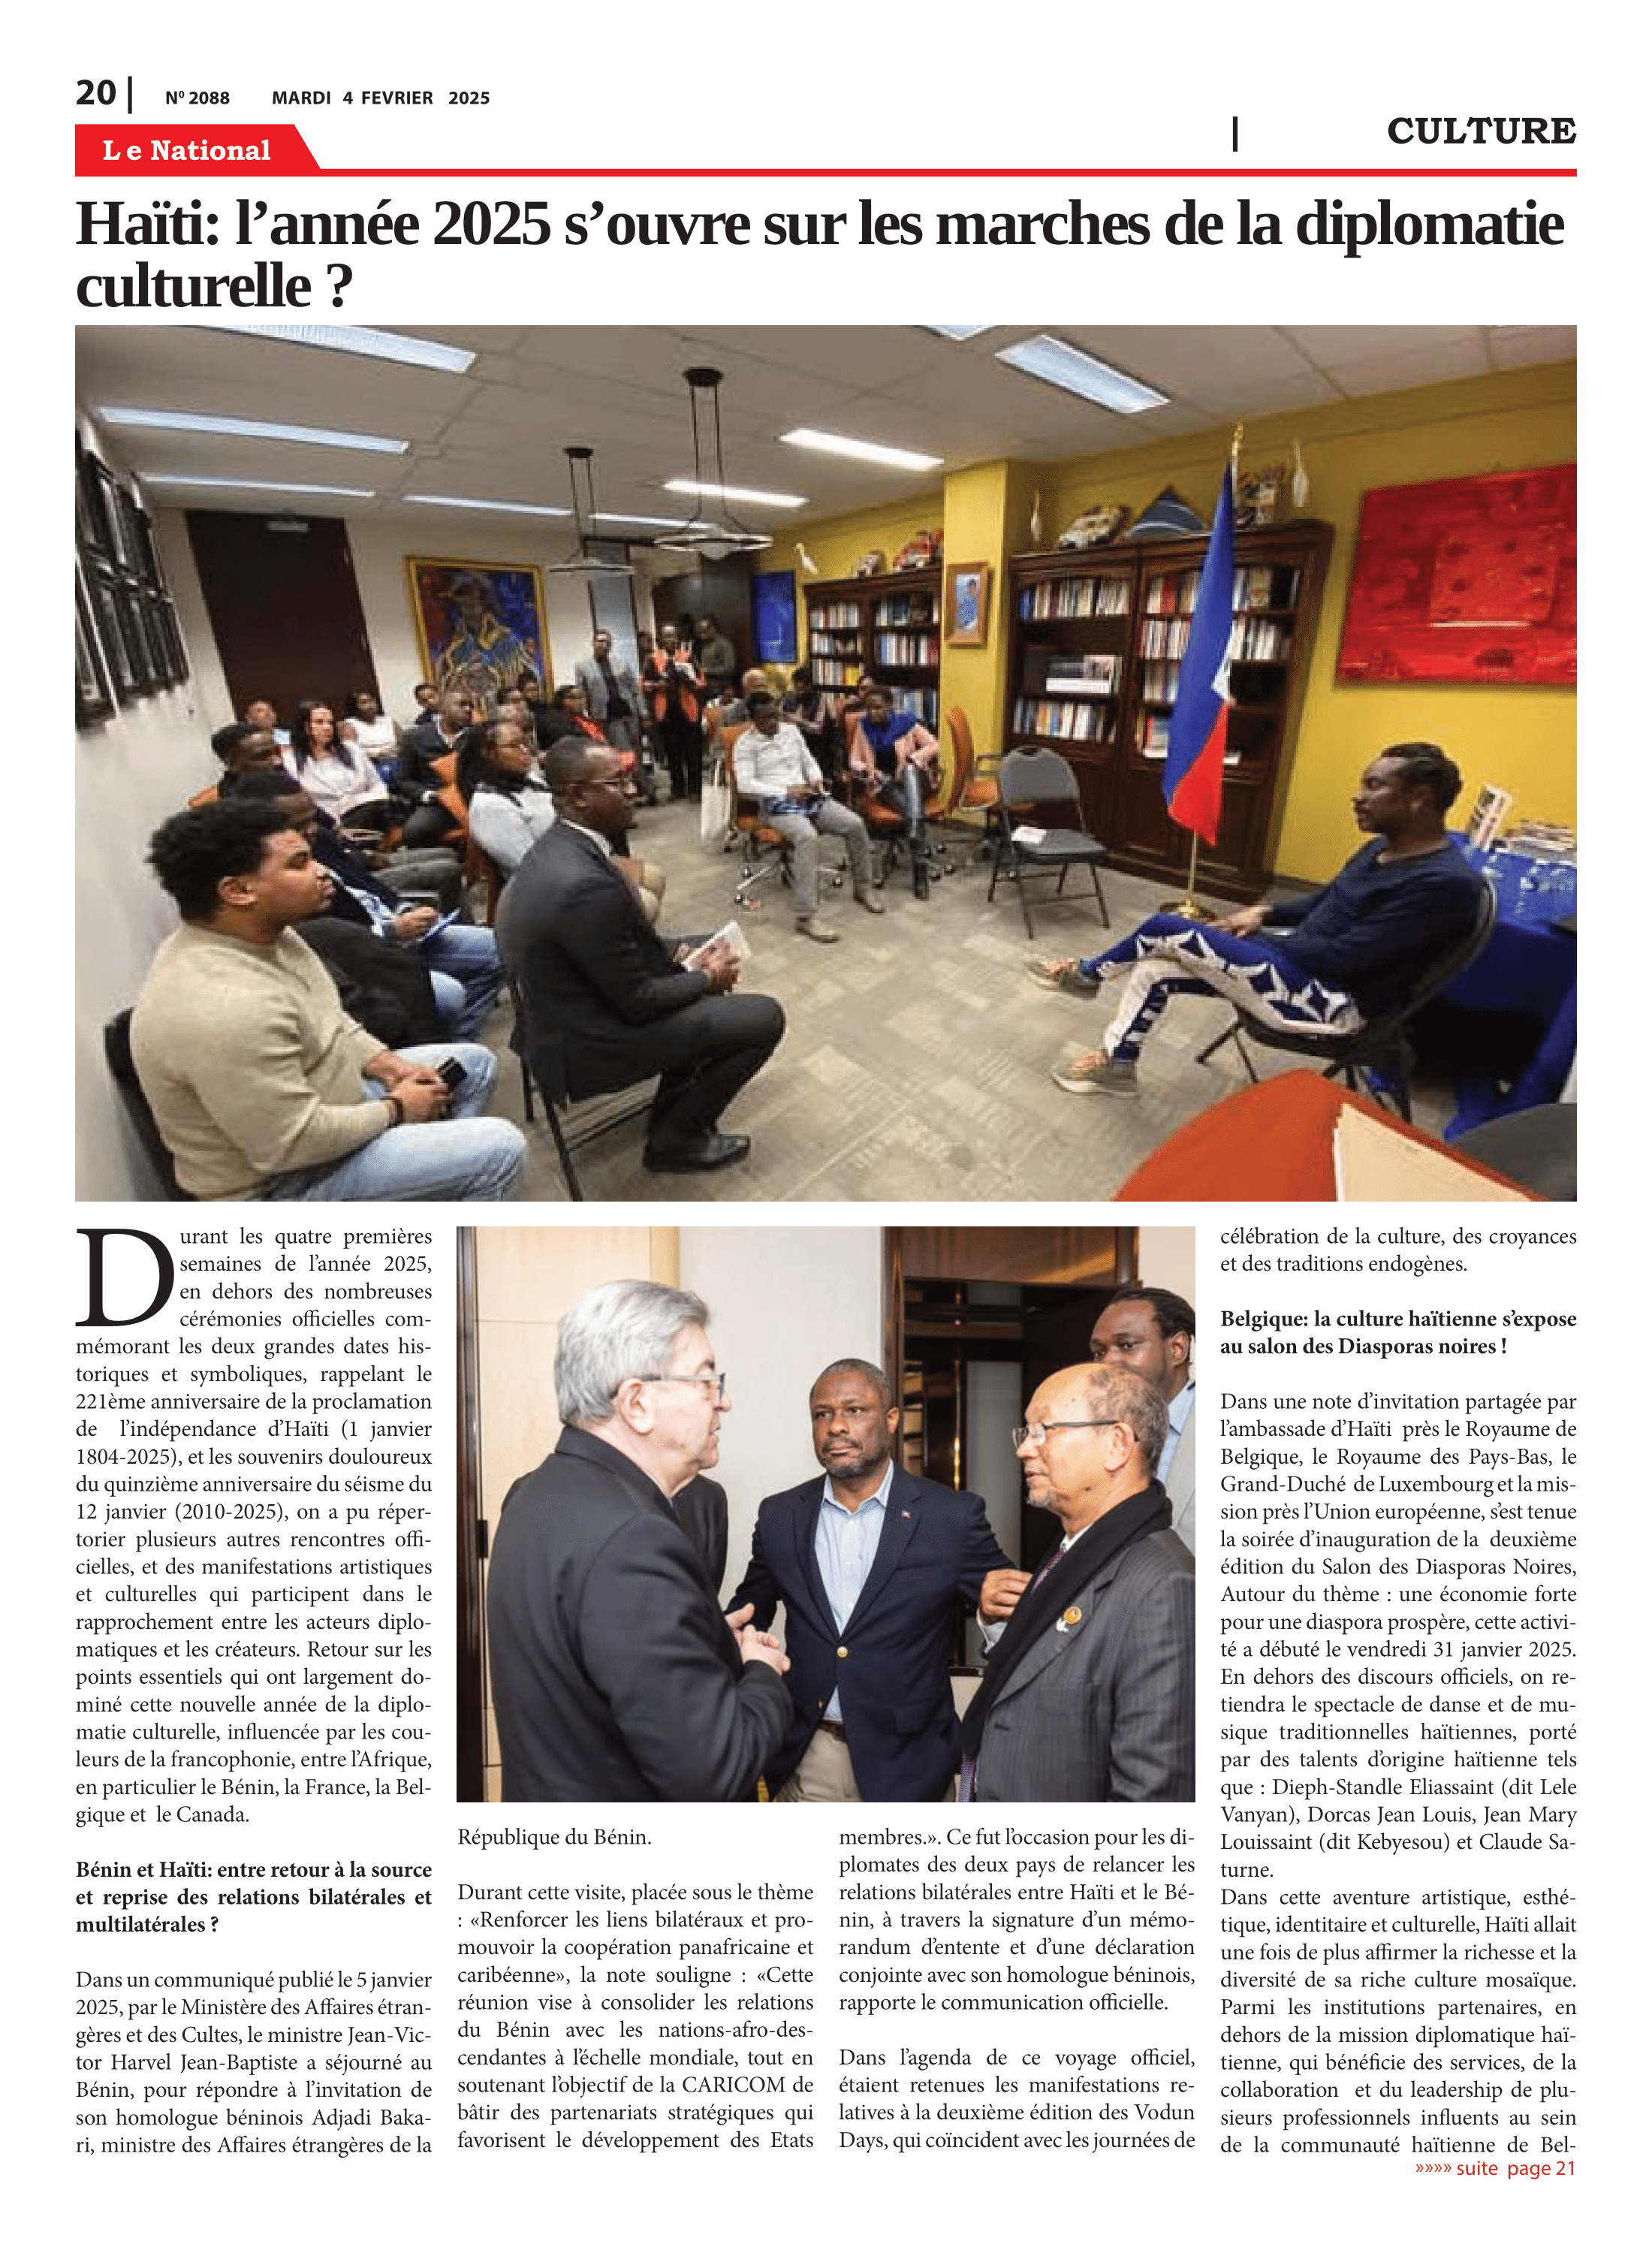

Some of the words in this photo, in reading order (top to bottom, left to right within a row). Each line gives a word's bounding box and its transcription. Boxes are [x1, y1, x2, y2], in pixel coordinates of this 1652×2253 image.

[76, 79, 116, 106] 20
[188, 91, 231, 105] 2088
[272, 90, 331, 105] MARDI
[342, 91, 354, 105] 4
[361, 90, 433, 105] FEVRIER
[448, 91, 490, 105] 2025
[1388, 116, 1578, 145] CULTURE
[150, 139, 271, 161] National
[75, 198, 219, 246] Haïti:
[235, 198, 420, 246] l’année
[433, 201, 551, 246] 2025
[565, 201, 751, 246] s’ouvre
[764, 213, 848, 246] sur
[858, 198, 924, 246] les
[936, 198, 1151, 246] marches
[1165, 198, 1224, 246] de
[1236, 198, 1283, 246] la
[1296, 198, 1565, 259] diplomatie
[77, 261, 312, 308] culturelle
[1220, 1226, 1319, 1244] célébration
[1326, 1226, 1349, 1244] de
[1355, 1226, 1371, 1244] la
[1377, 1226, 1446, 1247] culture,
[1452, 1226, 1482, 1244] des
[1488, 1232, 1577, 1250] croyances
[179, 1255, 261, 1272] semaines
[274, 1253, 297, 1272] de
[309, 1253, 371, 1272] l’année
[384, 1255, 432, 1274] 2025,
[1220, 1309, 1308, 1332] Belgique:
[1313, 1309, 1332, 1327] la
[1336, 1309, 1403, 1327] culture
[1408, 1309, 1497, 1327] haïtienne
[1503, 1309, 1577, 1332] s’expose
[1220, 1342, 1244, 1355] au
[1248, 1336, 1298, 1355] salon
[1302, 1336, 1334, 1355] des
[1337, 1338, 1433, 1359] Diasporas
[1438, 1338, 1497, 1355] noires
[76, 1392, 146, 1410] 221ème
[151, 1393, 261, 1410] anniversaire
[265, 1392, 287, 1410] de
[291, 1392, 308, 1410] la
[312, 1392, 433, 1415] proclamation
[1220, 1392, 1268, 1410] Dans
[1273, 1398, 1307, 1410] une
[1312, 1395, 1352, 1410] note
[1357, 1392, 1460, 1410] d’invitation
[1464, 1392, 1542, 1416] partagée
[1546, 1397, 1578, 1415] par
[77, 1503, 98, 1519] 12
[104, 1503, 167, 1525] janvier
[175, 1501, 289, 1523] (2010-2025),
[297, 1507, 321, 1520] on
[328, 1507, 339, 1519] a
[345, 1507, 370, 1525] pu
[377, 1502, 432, 1525] réper-
[1220, 1503, 1259, 1520] sion
[1262, 1502, 1300, 1525] près
[1303, 1501, 1371, 1520] l’Union
[1375, 1502, 1485, 1525] européenne,
[1490, 1501, 1524, 1520] s’est
[1527, 1504, 1577, 1520] tenue
[75, 1612, 214, 1636] rapprochement
[221, 1615, 267, 1630] entre
[274, 1612, 298, 1630] les
[306, 1615, 370, 1630] acteurs
[378, 1612, 432, 1636] diplo-
[1220, 1640, 1237, 1657] té
[1243, 1645, 1253, 1657] a
[1259, 1639, 1320, 1657] débuté
[1325, 1639, 1341, 1657] le
[1346, 1639, 1427, 1657] vendredi
[1433, 1641, 1453, 1657] 31
[1460, 1641, 1523, 1663] janvier
[1529, 1641, 1576, 1657] 2025.
[75, 1783, 98, 1796] en
[102, 1777, 197, 1801] particulier
[200, 1777, 216, 1796] le
[221, 1778, 279, 1798] Bénin,
[284, 1777, 300, 1795] la
[305, 1778, 370, 1798] France,
[375, 1777, 391, 1795] la
[395, 1777, 432, 1796] Bel-
[457, 1827, 560, 1850] République
[565, 1827, 589, 1845] du
[593, 1828, 652, 1845] Bénin.
[75, 1860, 132, 1878] Bénin
[137, 1862, 155, 1878] et
[158, 1861, 213, 1878] Haïti:
[217, 1862, 266, 1878] entre
[270, 1862, 330, 1878] retour
[334, 1860, 345, 1878] à
[349, 1860, 367, 1878] la
[371, 1865, 433, 1878] source
[75, 1890, 94, 1905] et
[102, 1888, 168, 1911] reprise
[176, 1887, 209, 1905] des
[217, 1887, 300, 1905] relations
[308, 1887, 405, 1905] bilatérales
[415, 1890, 433, 1905] et
[75, 1914, 206, 1933] multilatérales
[1220, 1948, 1255, 1961] une
[1259, 1942, 1291, 1961] fois
[1296, 1942, 1318, 1961] de
[1322, 1942, 1360, 1966] plus
[1365, 1942, 1438, 1961] affirmer
[1442, 1942, 1459, 1960] la
[1464, 1942, 1535, 1961] richesse
[1539, 1945, 1557, 1961] et
[1560, 1942, 1578, 1960] la
[839, 1995, 916, 2016] rapporte
[921, 1992, 936, 2010] le
[941, 1994, 1084, 2010] communication
[1089, 1992, 1168, 2010] officielle.
[457, 2078, 546, 2093] soutenant
[551, 2075, 629, 2098] l’objectif
[632, 2075, 653, 2093] de
[659, 2075, 676, 2093] la
[682, 2076, 786, 2093] CARICOM
[792, 2075, 814, 2093] de
[839, 2076, 900, 2093] étaient
[909, 2078, 984, 2093] retenues
[995, 2075, 1018, 2093] les
[1028, 2075, 1159, 2093] manifestations
[1170, 2081, 1195, 2093] re-
[1220, 2109, 1273, 2126] sieurs
[1283, 2107, 1410, 2131] professionnels
[1420, 2107, 1499, 2126] influents
[1509, 2113, 1531, 2126] au
[1541, 2109, 1578, 2126] sein
[76, 2137, 95, 2155] ri,
[101, 2137, 176, 2153] ministre
[181, 2135, 211, 2153] des
[216, 2135, 286, 2153] Affaires
[291, 2136, 384, 2159] étrangères
[389, 2135, 411, 2153] de
[416, 2135, 433, 2153] la
[1457, 2160, 1499, 2176] suite
[1508, 2164, 1551, 2180] page
[1555, 2160, 1574, 2176] 21
